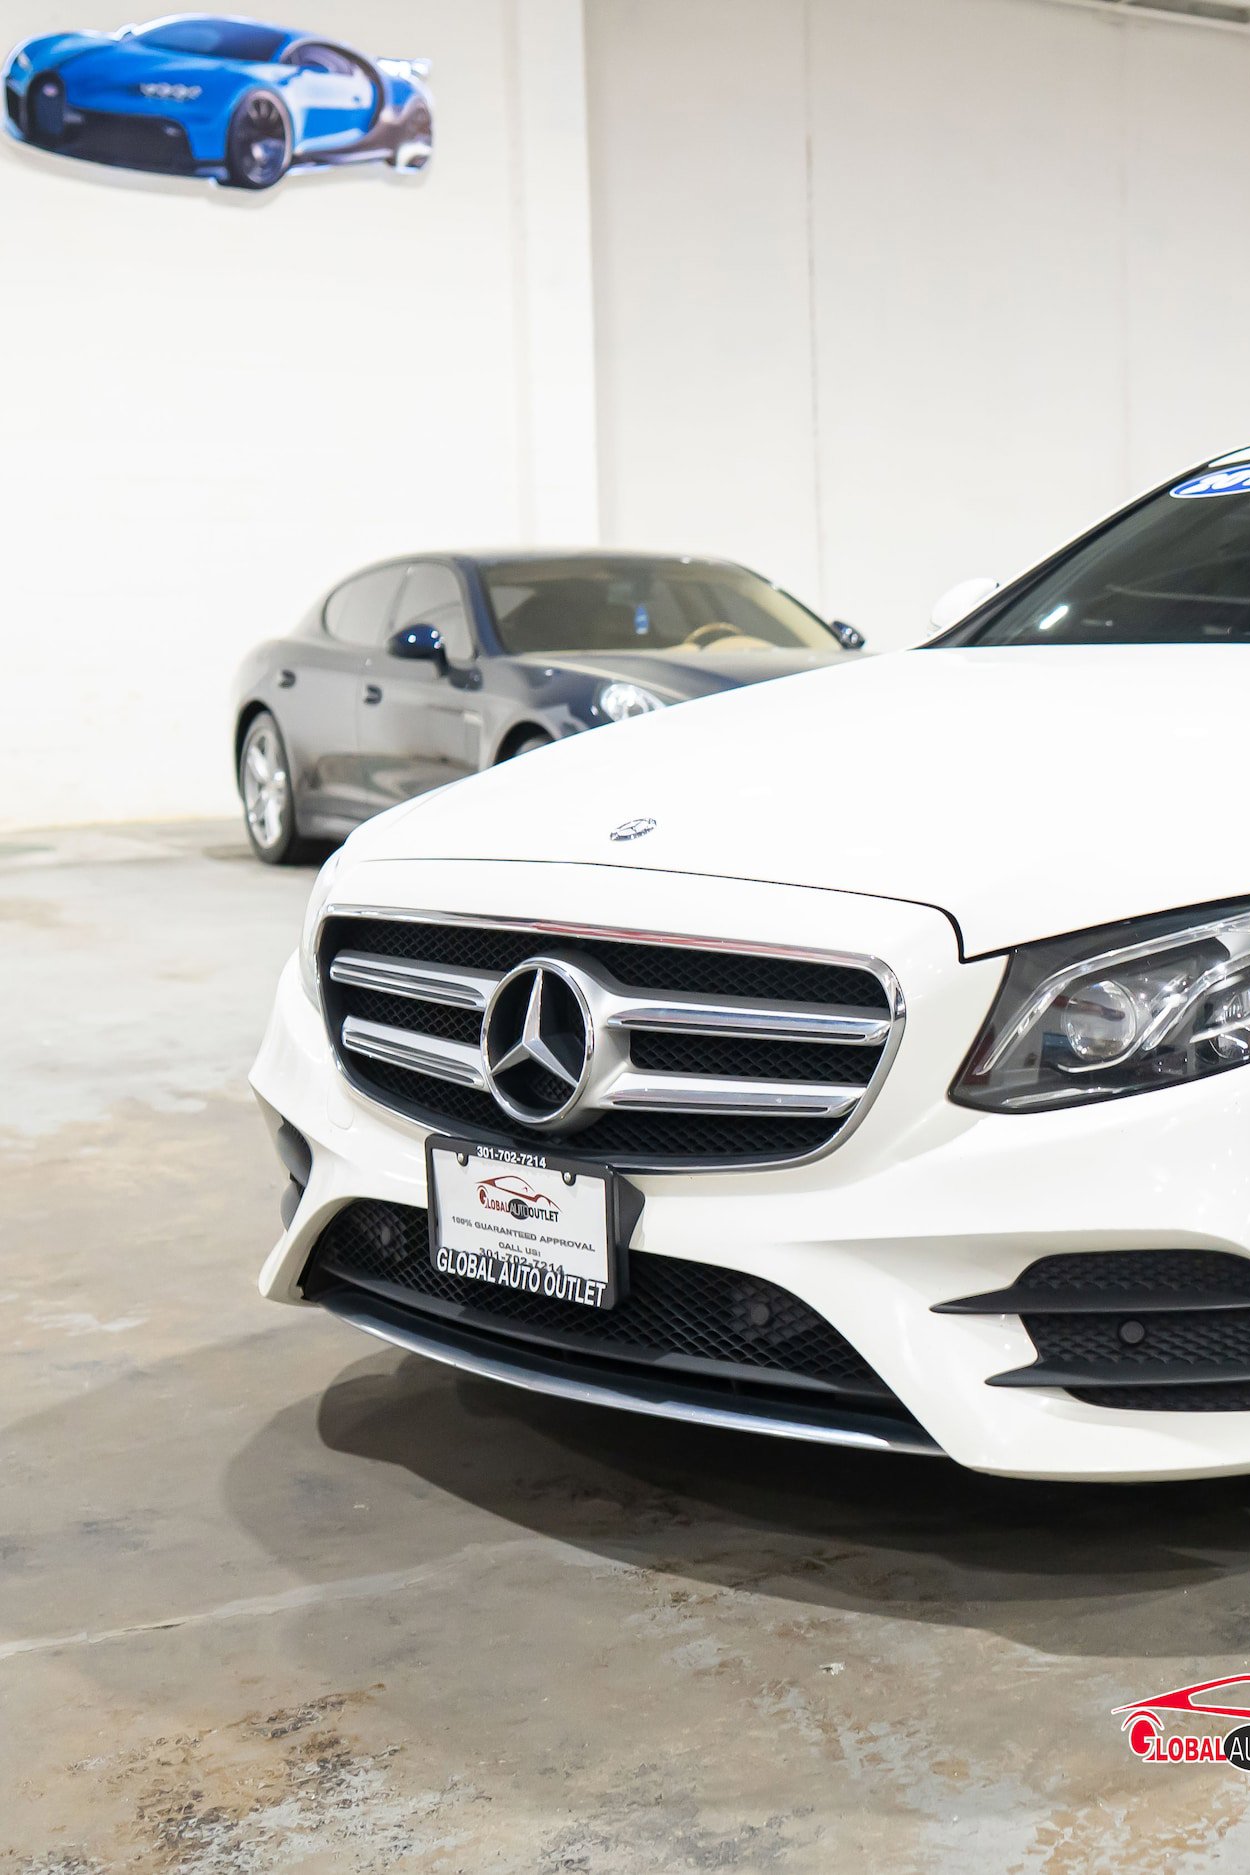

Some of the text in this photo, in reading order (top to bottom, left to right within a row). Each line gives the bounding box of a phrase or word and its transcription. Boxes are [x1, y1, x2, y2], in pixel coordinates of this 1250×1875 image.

[476, 1146, 546, 1168] 301-702-7214
[479, 1189, 510, 1213] GLOBAL
[528, 1207, 559, 1222] OUTLET
[451, 1216, 595, 1252] 100% GUARANTEED APPROVAL
[498, 1241, 522, 1253] CALL
[437, 1247, 606, 1307] GLOBAL AUTO OUTLET
